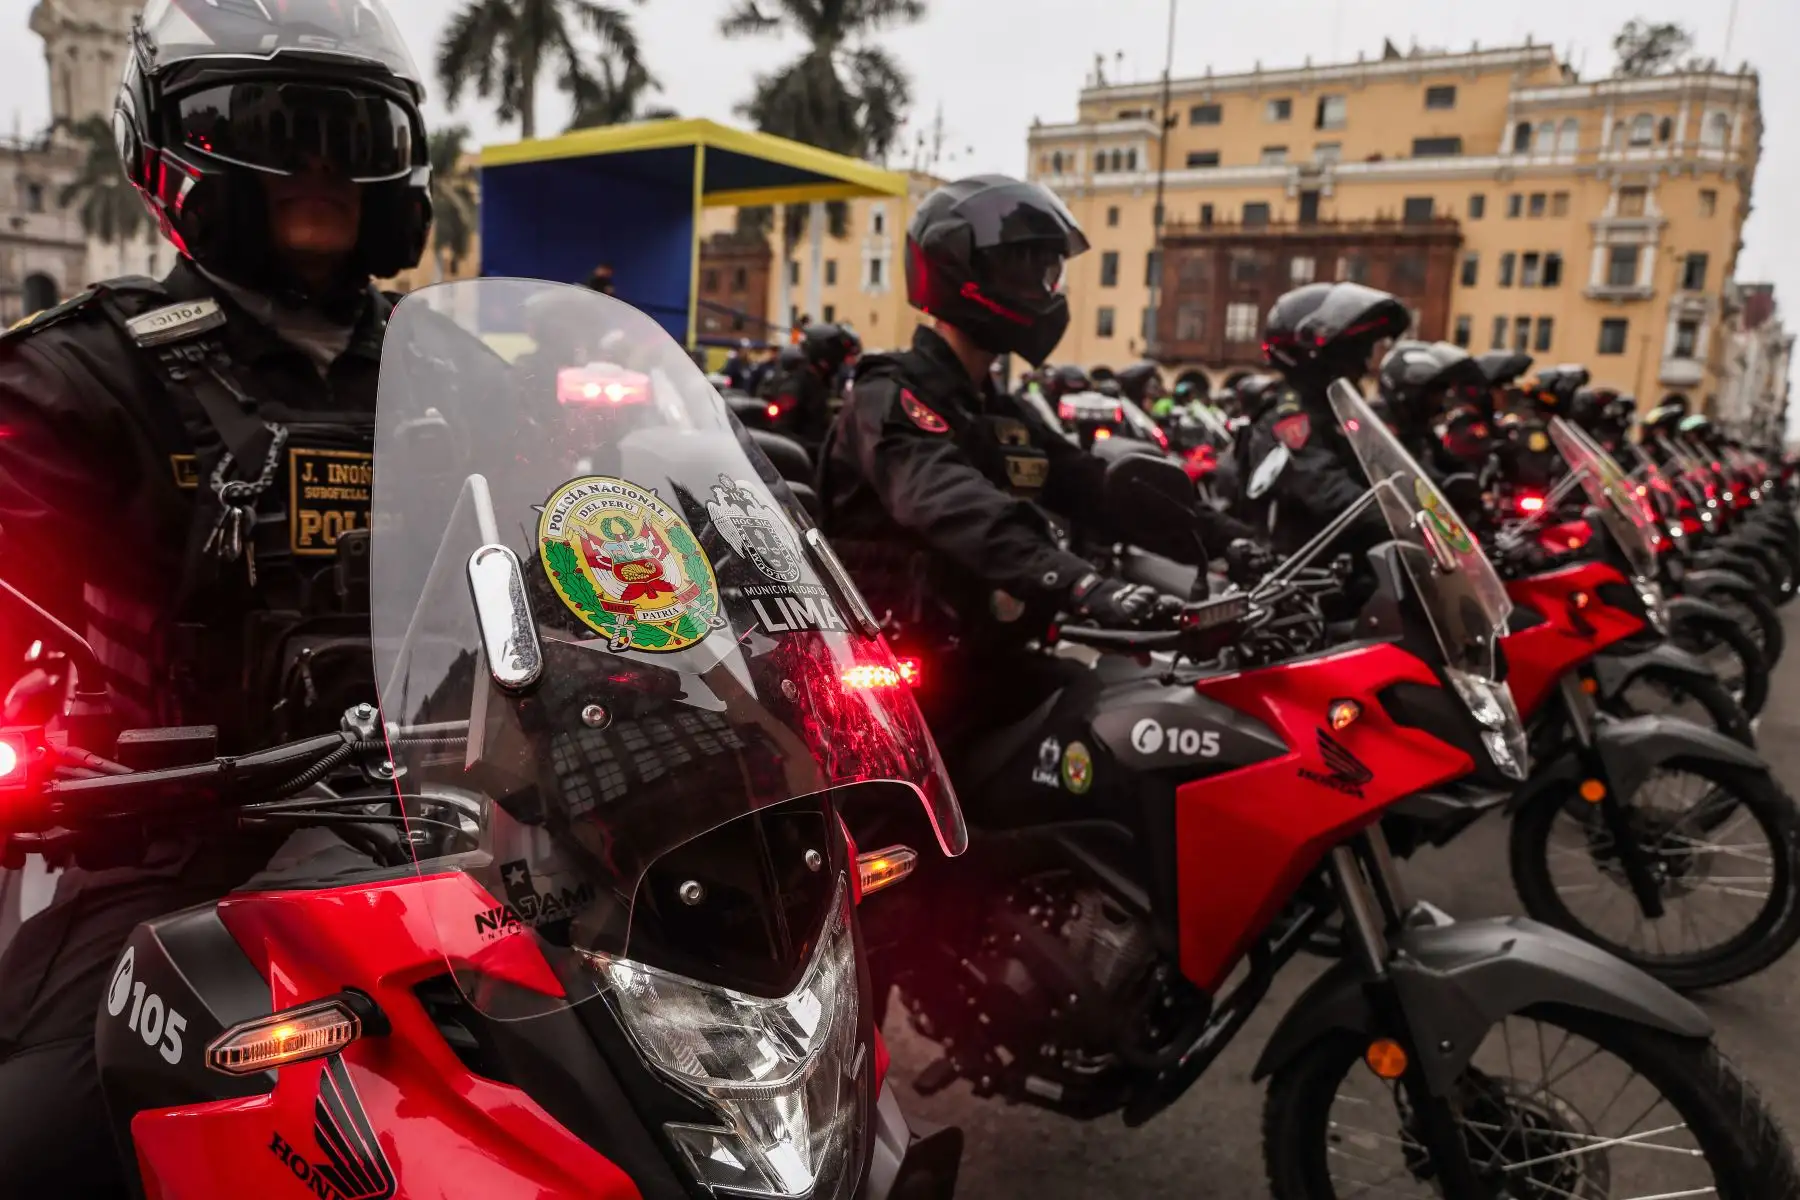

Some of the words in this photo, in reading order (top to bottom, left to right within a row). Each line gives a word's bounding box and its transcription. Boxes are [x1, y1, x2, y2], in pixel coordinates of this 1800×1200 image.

[302, 462, 318, 483] J.
[549, 488, 587, 532] POLICÍA
[588, 484, 665, 517] NACIONAL
[579, 503, 600, 518] DEL
[299, 508, 373, 547] POL
[743, 585, 818, 597] MUNICIPALIDAD
[642, 607, 679, 620] PATRIA
[751, 597, 849, 633] LIMA
[1166, 727, 1220, 757] 105
[128, 981, 188, 1065] 105
[267, 1131, 342, 1200] HON
